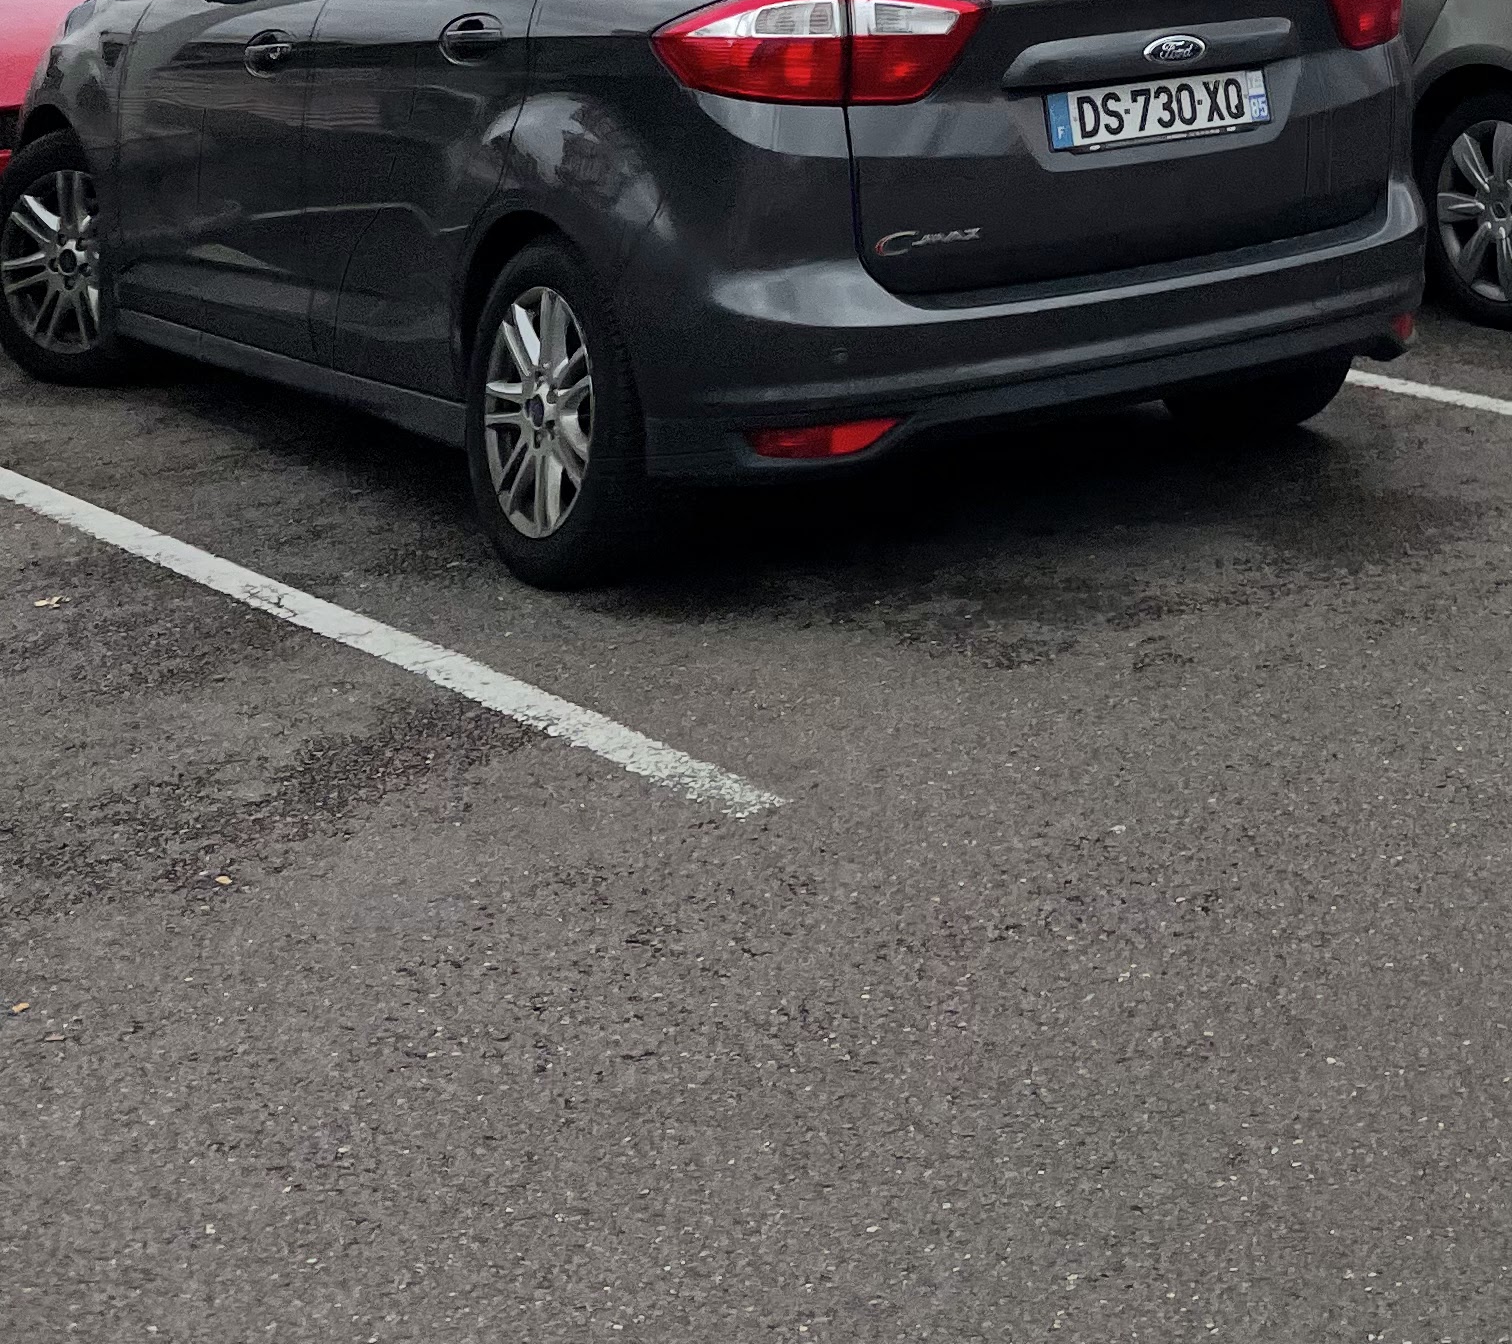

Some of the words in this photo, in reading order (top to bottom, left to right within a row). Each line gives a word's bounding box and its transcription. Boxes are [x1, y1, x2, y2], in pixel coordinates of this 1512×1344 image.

[1159, 40, 1194, 60] Ford
[1076, 77, 1246, 140] DS-730-XQ
[1250, 96, 1268, 118] 85
